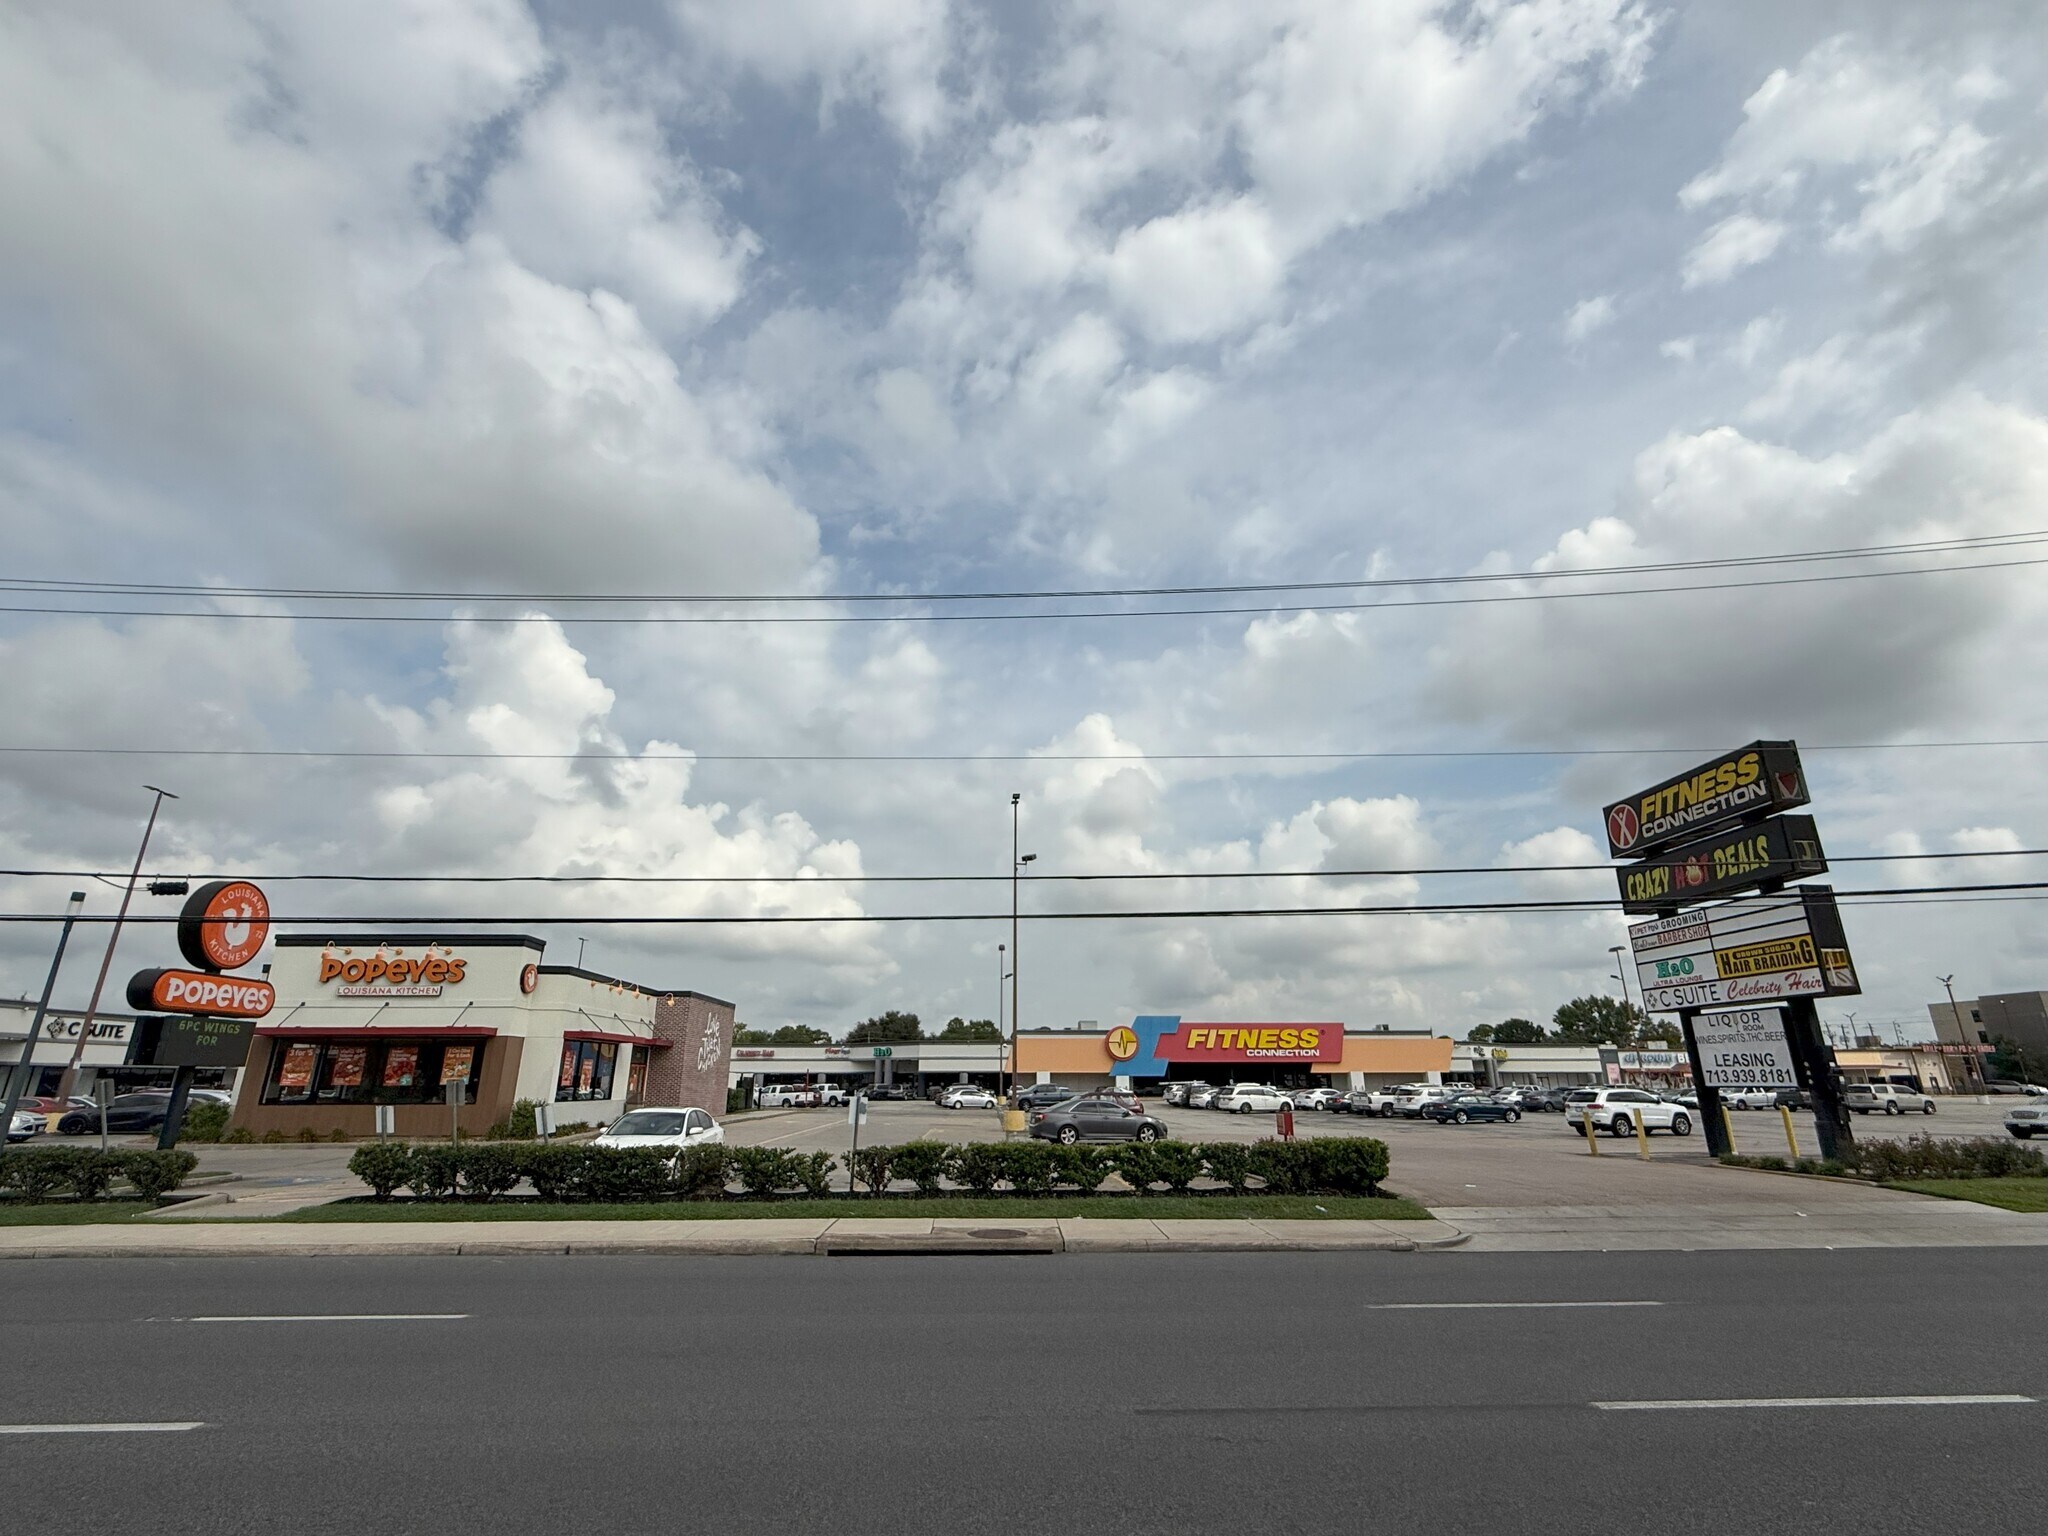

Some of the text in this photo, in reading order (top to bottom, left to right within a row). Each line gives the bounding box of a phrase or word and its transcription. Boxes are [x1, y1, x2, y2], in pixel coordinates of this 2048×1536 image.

[1640, 752, 1760, 824] FITNESS
[1641, 780, 1767, 838] CONNECTION
[1626, 865, 1669, 900] CRAZY
[1713, 835, 1770, 880] DEALS
[221, 888, 265, 917] LOUISIANA
[1660, 912, 1704, 930] GROOMING
[1657, 928, 1687, 945] BARBER
[1687, 925, 1708, 939] SHOP
[209, 938, 249, 962] KITCHEN
[1720, 952, 1752, 975] HAIR
[1754, 938, 1814, 971] BRAIDING
[1764, 943, 1792, 954] SUGAR
[319, 958, 467, 984] POPEYES
[1655, 957, 1694, 979] H2O
[1652, 974, 1704, 987] ULTRA LOUNGE
[1727, 972, 1822, 1000] Celebrity Hair
[165, 977, 270, 1011] POPEYES
[337, 987, 439, 995] LOUISIANA KITCHEN
[1659, 984, 1721, 1007] C SUITE
[67, 1021, 81, 1036] C
[179, 1020, 241, 1035] 6PC WINGS
[1742, 1024, 1765, 1032] ROOM
[195, 1035, 218, 1046] FOR
[1187, 1028, 1320, 1049] FITNESS
[1246, 1049, 1320, 1057] CONNECTION
[1714, 1053, 1776, 1067] LEASING
[1705, 1068, 1793, 1084] 713.939.8181
